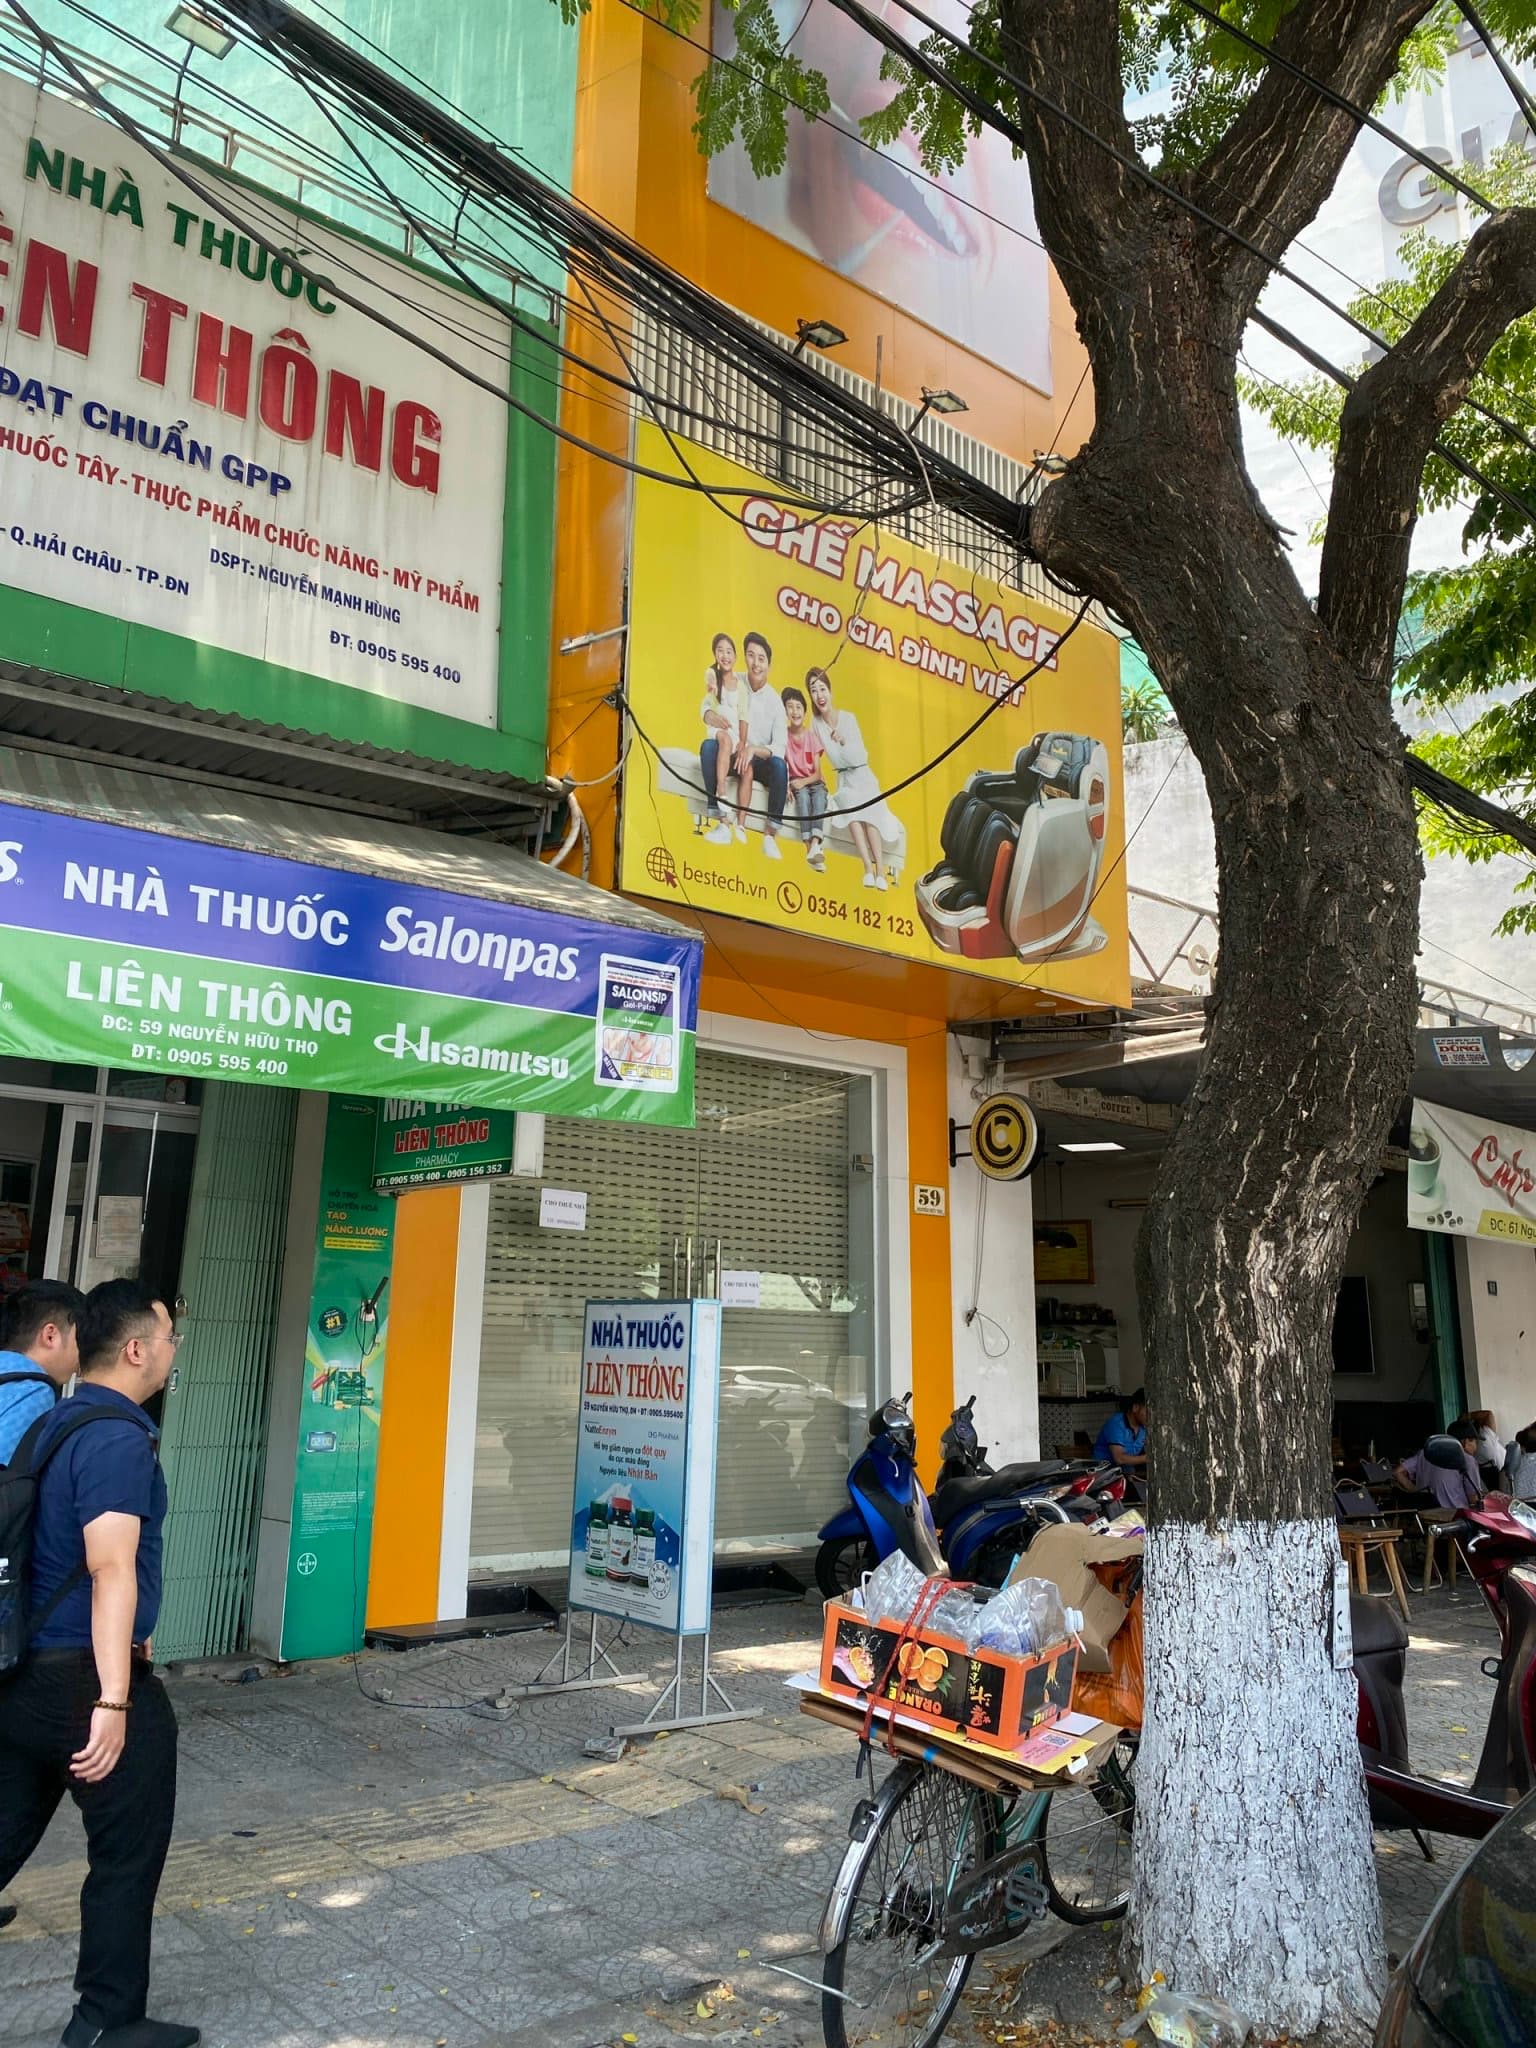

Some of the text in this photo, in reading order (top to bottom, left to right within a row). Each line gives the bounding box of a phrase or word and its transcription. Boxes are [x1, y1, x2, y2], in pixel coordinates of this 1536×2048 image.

[25, 137, 337, 316] NHÀ THUỐC
[130, 282, 442, 496] THÔNG
[82, 401, 212, 472] CHUẨN
[221, 454, 292, 496] GPP
[72, 546, 122, 574] CHÂU
[135, 566, 190, 596] TP.ĐN
[196, 497, 260, 538] PHẨM
[264, 522, 320, 558] CHỨC
[325, 543, 379, 578] NĂNG
[394, 567, 422, 593] MỸ
[427, 579, 480, 613] PHẨM
[210, 548, 401, 624] DSPT: NGUYỄN MẠNH HÙNG
[855, 545, 1060, 670] MASSAGE
[329, 630, 461, 684] ĐT: 0905 595 400
[776, 586, 1025, 708] CHO GIA ĐÌNH VIỆT
[63, 862, 169, 916] NHÀ
[189, 884, 350, 947] THUỐC
[682, 860, 768, 901] bestech.vn
[807, 894, 914, 938] 0354 182 123
[380, 906, 579, 982] Salonpas
[66, 959, 352, 1036] LIÊN THÔNG
[611, 985, 667, 1005] SALONSIP
[102, 1015, 319, 1057] ĐC: 59 NGUYỄN HỮU THỌ
[131, 1044, 288, 1076] ĐT: 0905 595 400
[373, 1023, 571, 1080] Hisamitsu
[394, 1116, 490, 1153] LIÊN THÔNG
[415, 1151, 460, 1167] PHARMACY
[389, 1175, 408, 1185] 0905
[425, 1171, 441, 1181] 400
[447, 1168, 467, 1178] 0905
[469, 1166, 485, 1176] 156
[486, 1164, 502, 1174] 352
[919, 1189, 940, 1207] 59
[1490, 1218, 1506, 1233] ĐC:
[1509, 1221, 1518, 1234] 61
[591, 1312, 684, 1349] NHÀ THUỐC
[585, 1354, 684, 1401] LIÊN THÔNG
